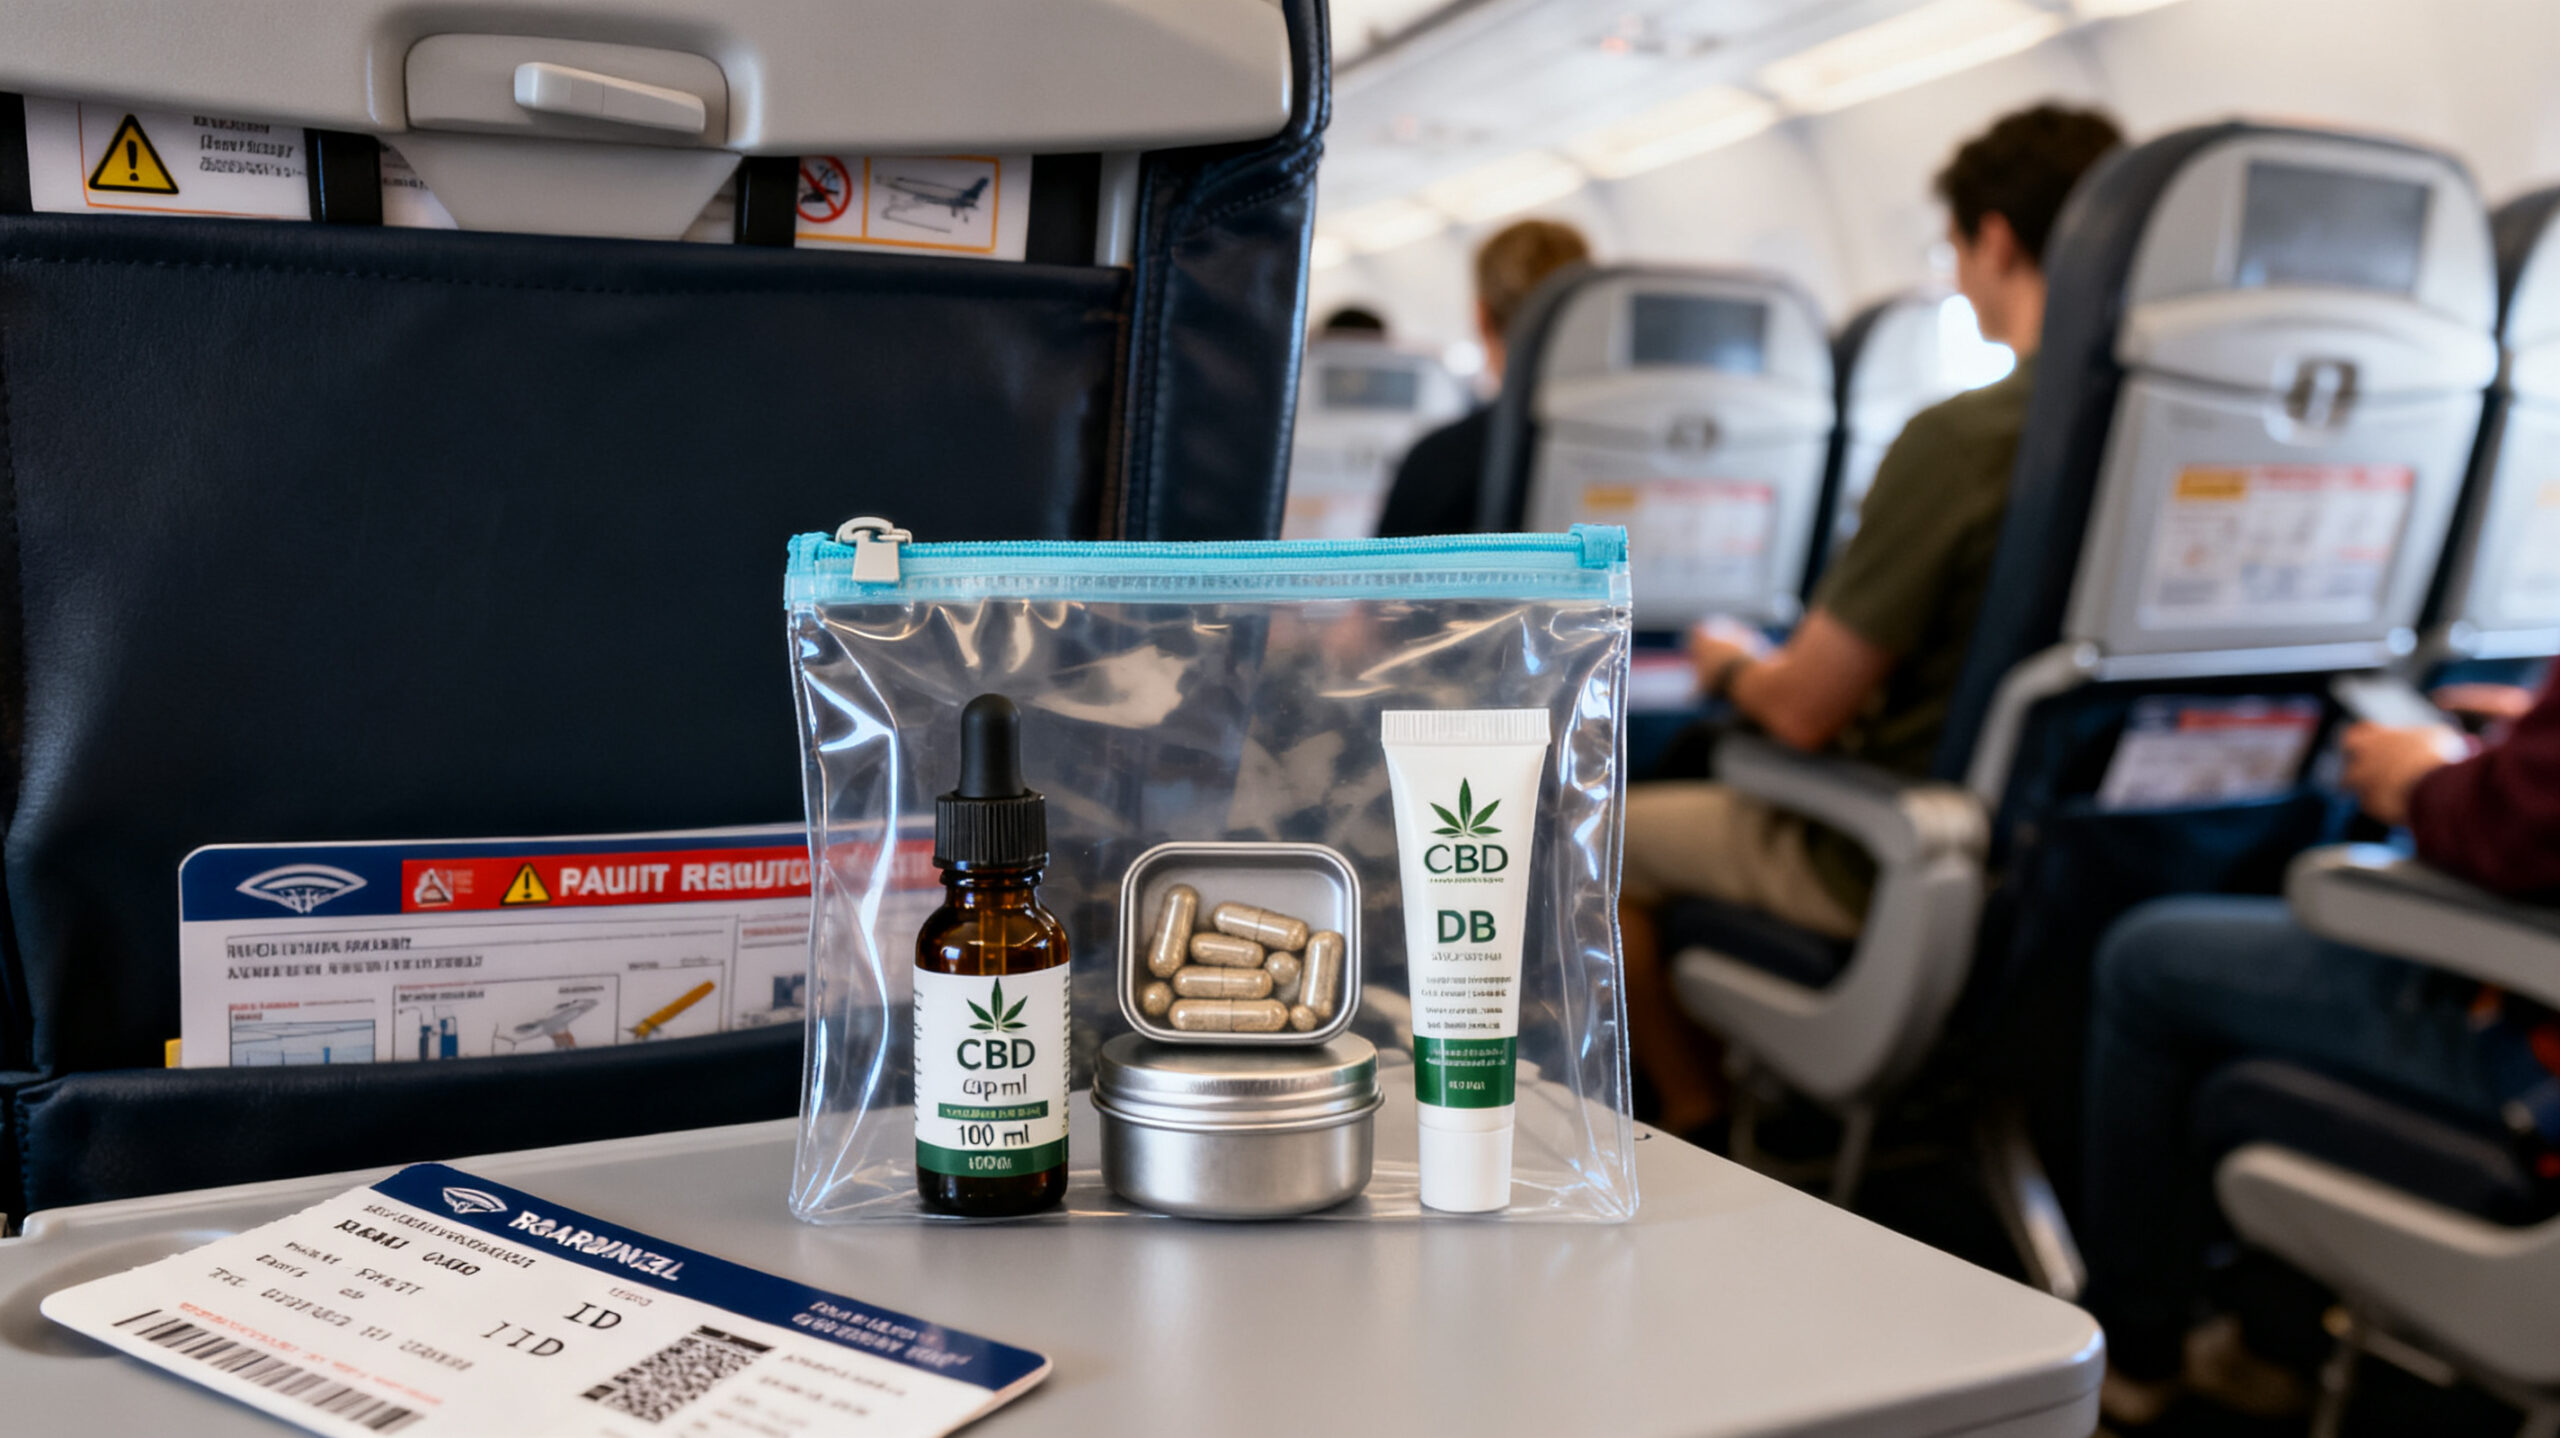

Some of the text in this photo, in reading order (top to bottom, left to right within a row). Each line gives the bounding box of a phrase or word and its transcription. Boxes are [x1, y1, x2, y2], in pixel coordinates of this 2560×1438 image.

[1424, 844, 1509, 874] CBD
[1437, 909, 1496, 943] DB
[957, 1038, 1036, 1070] CBD
[958, 1123, 1030, 1147] 100 ml
